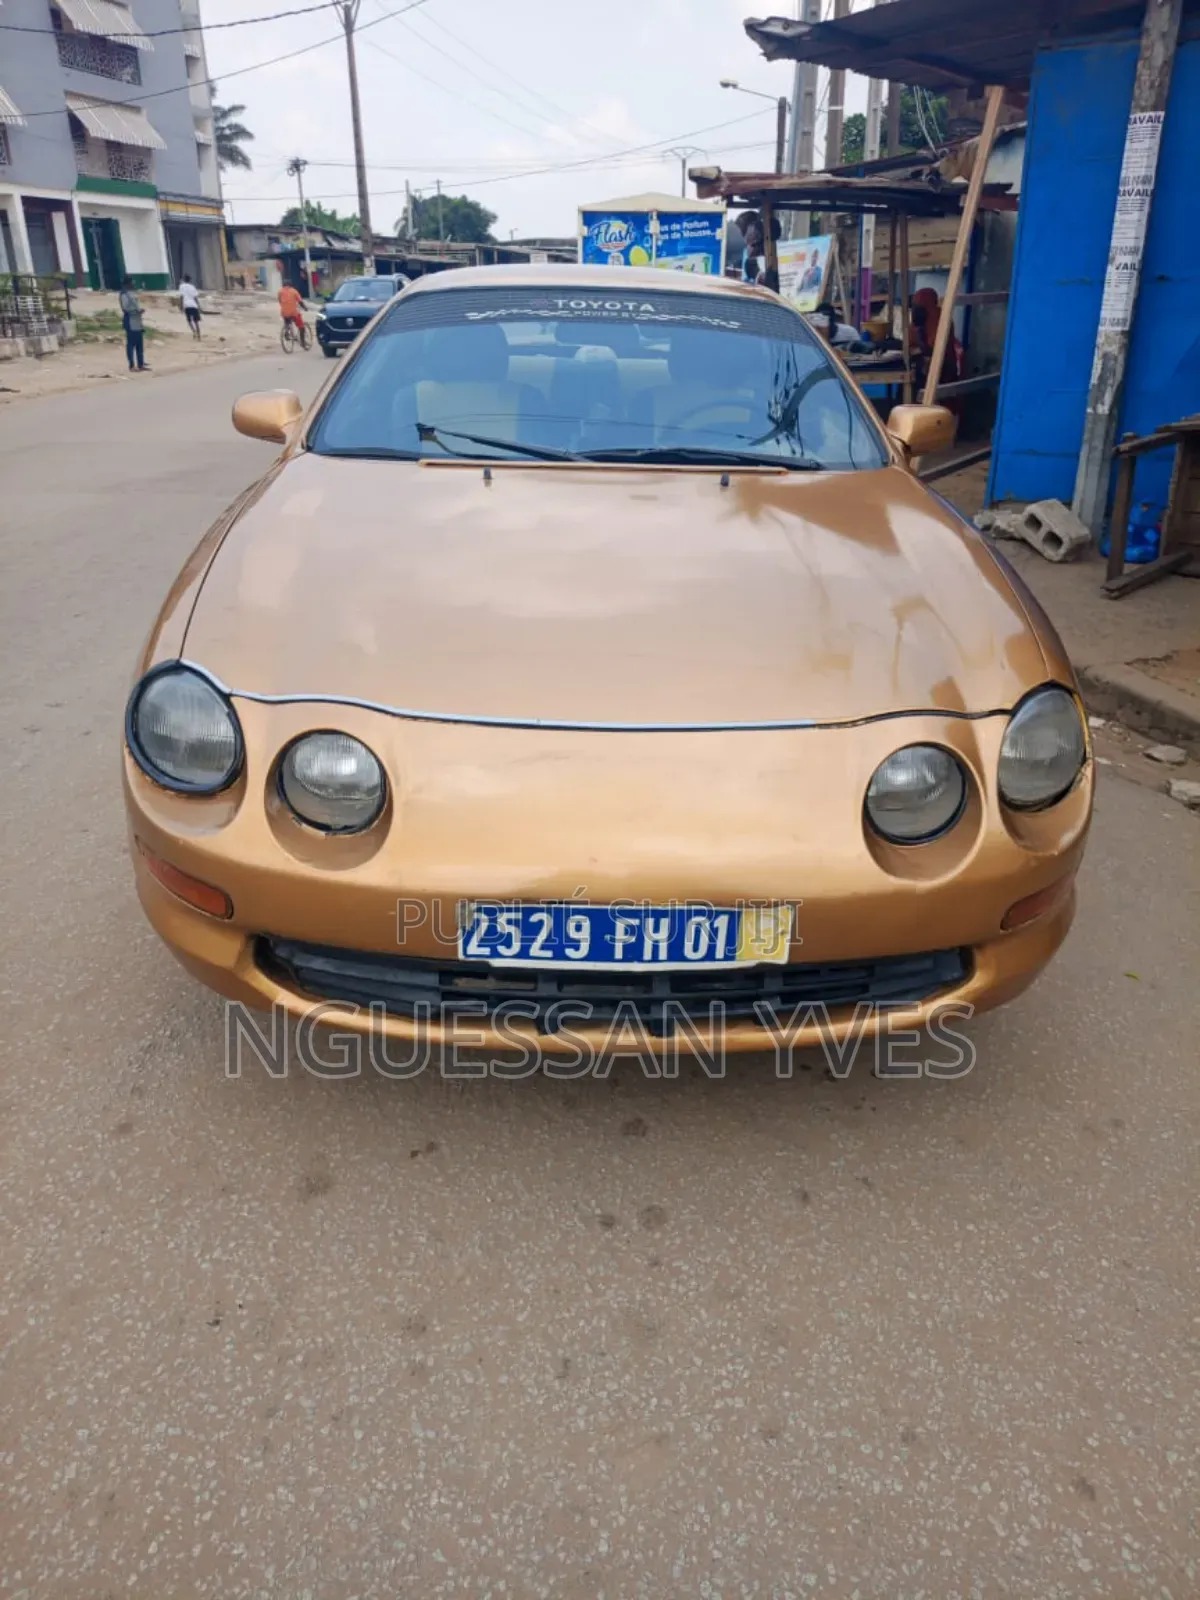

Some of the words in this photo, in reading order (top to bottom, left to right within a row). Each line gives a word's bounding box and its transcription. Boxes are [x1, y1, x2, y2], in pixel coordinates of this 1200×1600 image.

[553, 299, 656, 312] TOYOTA
[466, 911, 591, 959] 2529
[683, 914, 730, 960] 01
